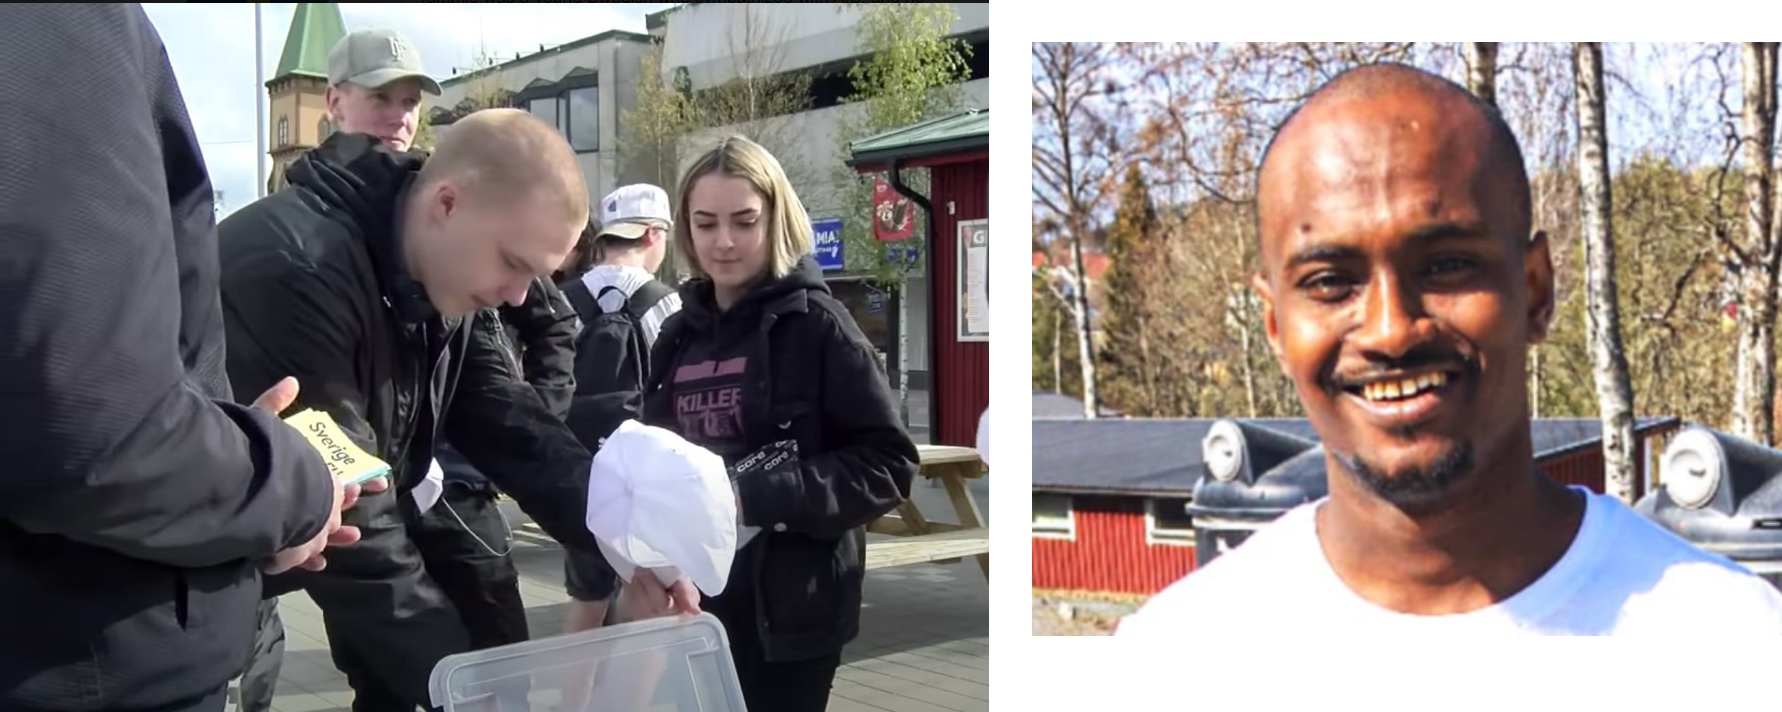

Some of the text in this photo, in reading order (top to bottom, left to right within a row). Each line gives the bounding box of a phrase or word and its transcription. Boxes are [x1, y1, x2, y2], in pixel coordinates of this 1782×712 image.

[973, 230, 988, 244] G
[309, 421, 356, 465] Sverige
[737, 451, 766, 472] core
